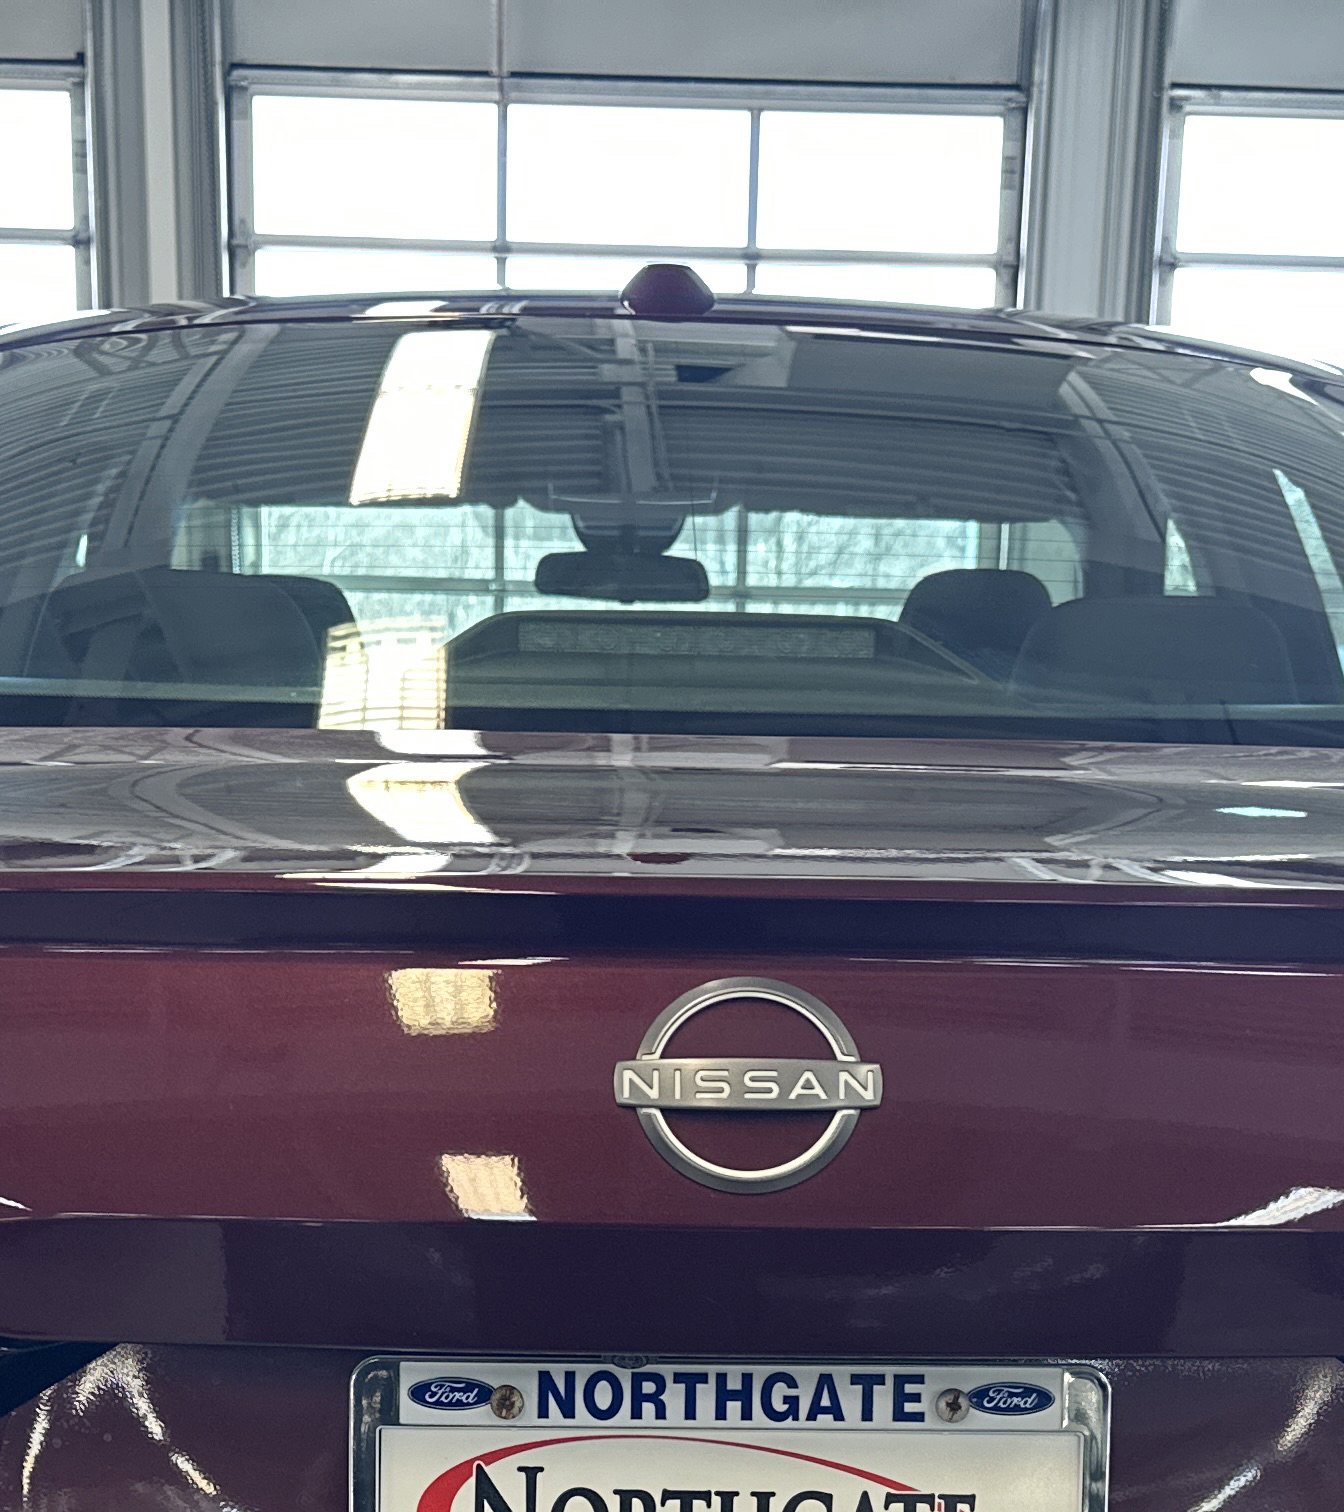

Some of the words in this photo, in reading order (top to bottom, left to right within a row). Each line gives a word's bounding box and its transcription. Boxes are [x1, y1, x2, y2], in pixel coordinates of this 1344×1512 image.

[622, 1069, 876, 1100] NISSAN
[424, 1375, 479, 1405] Ford
[536, 1370, 926, 1423] NORTHGATE
[982, 1387, 1039, 1410] Ford
